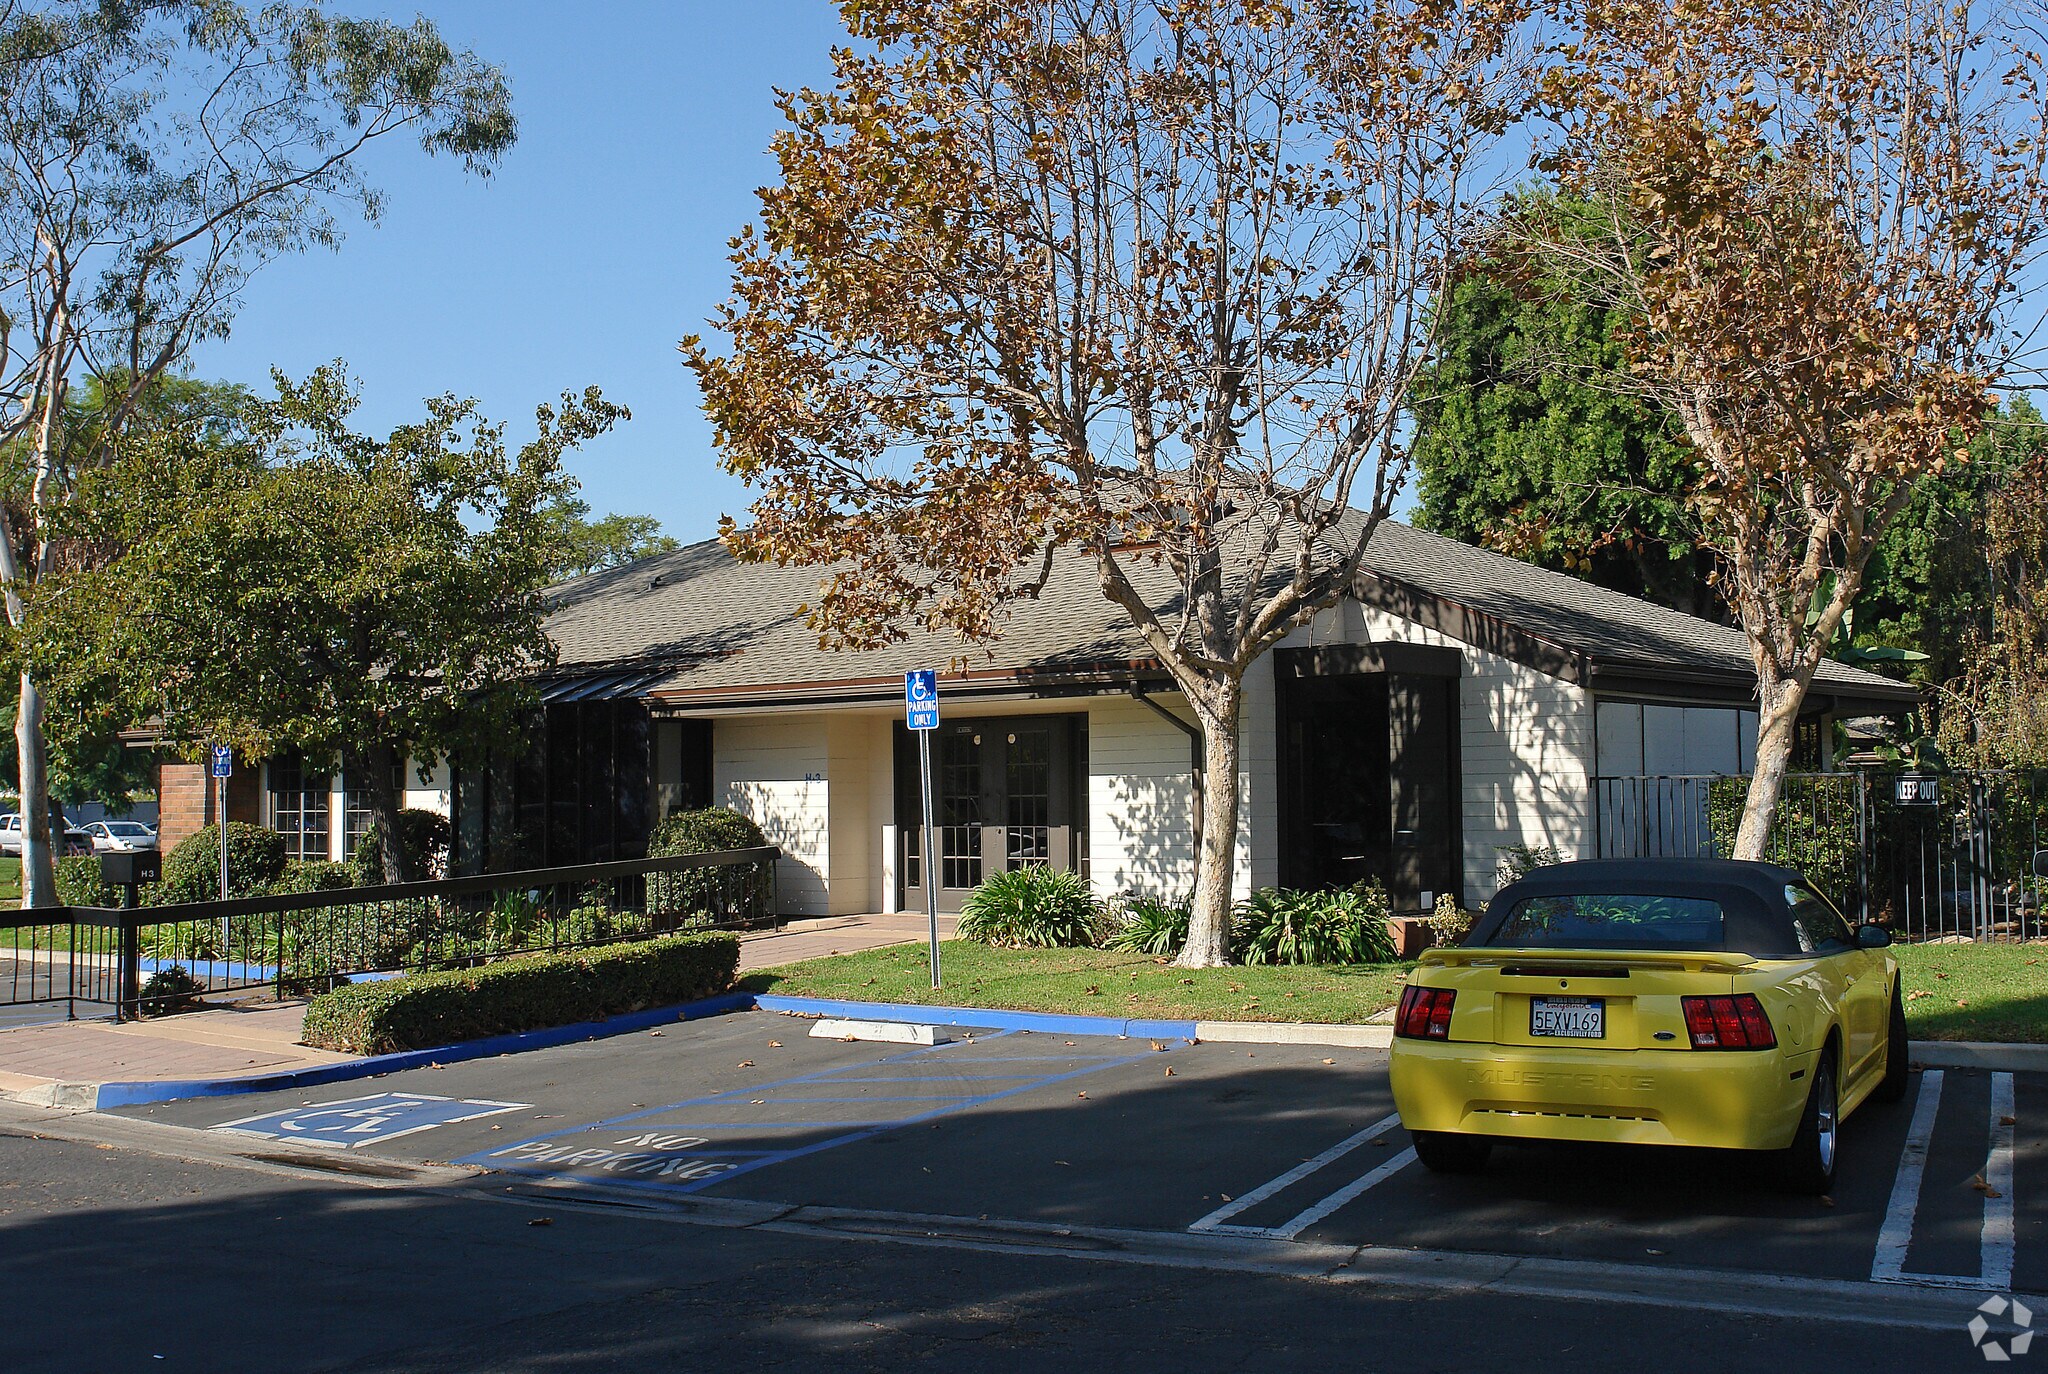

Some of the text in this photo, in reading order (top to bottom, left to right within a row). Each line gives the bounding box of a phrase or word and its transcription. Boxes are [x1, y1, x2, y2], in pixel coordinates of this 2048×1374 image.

[908, 700, 936, 712] PARKING
[914, 713, 932, 726] ONLY
[1896, 781, 1937, 799] KEEP OUT
[1535, 1011, 1600, 1031] 5EXV169
[1468, 1069, 1655, 1091] MUSTANG
[614, 1132, 710, 1150] NO
[489, 1142, 738, 1180] PARKING
